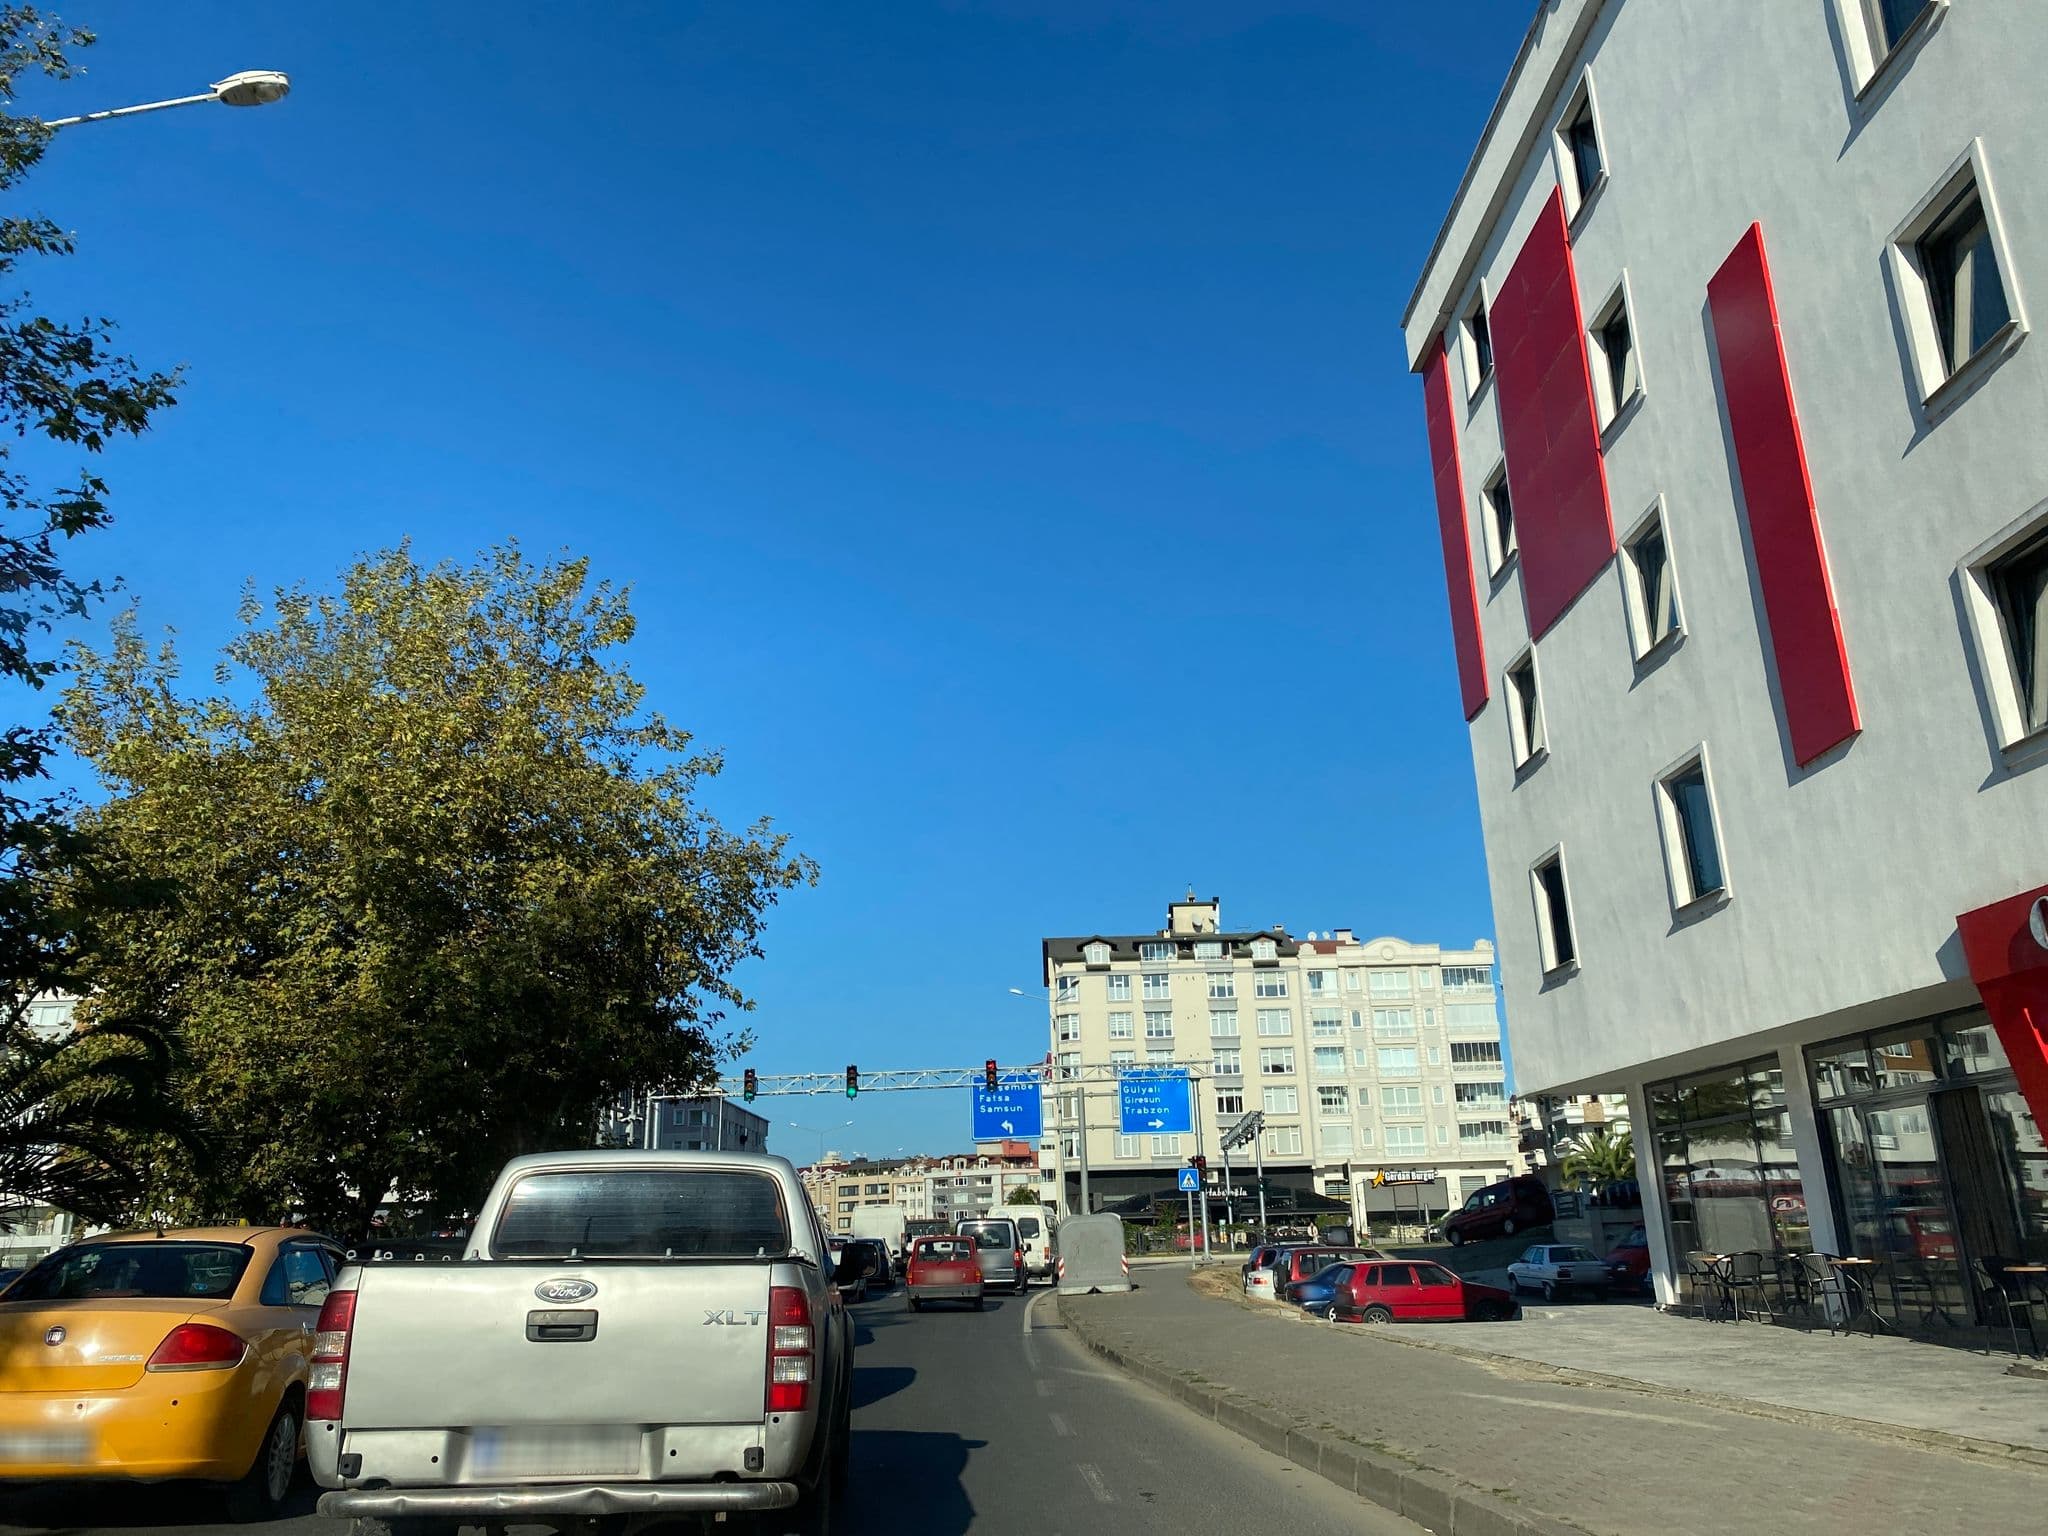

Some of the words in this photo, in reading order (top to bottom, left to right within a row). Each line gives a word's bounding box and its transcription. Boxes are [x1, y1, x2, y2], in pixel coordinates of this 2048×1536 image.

[979, 1094, 1011, 1103] Fatsa
[1124, 1096, 1161, 1104] Giresun
[980, 1105, 1024, 1113] Samsun
[1123, 1106, 1170, 1114] Trabzon
[1411, 1169, 1436, 1182] Burger
[702, 1310, 767, 1325] XLT
